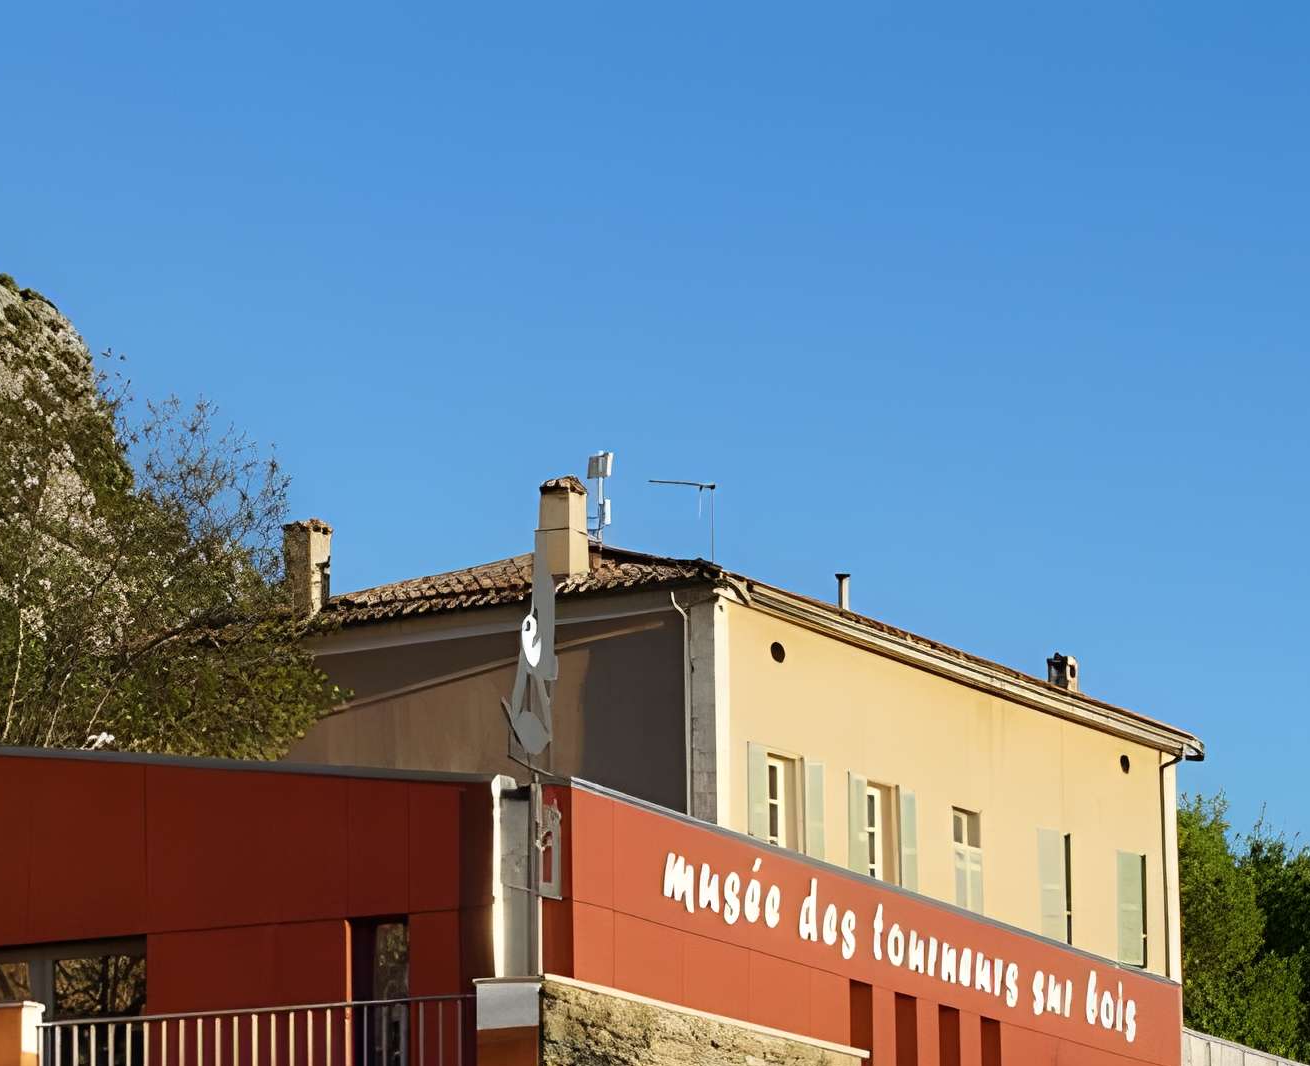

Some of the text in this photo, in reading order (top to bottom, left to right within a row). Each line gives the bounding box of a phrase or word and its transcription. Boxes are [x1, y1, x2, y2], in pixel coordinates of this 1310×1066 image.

[663, 852, 1137, 1043] musée des tourneurs sur bois
